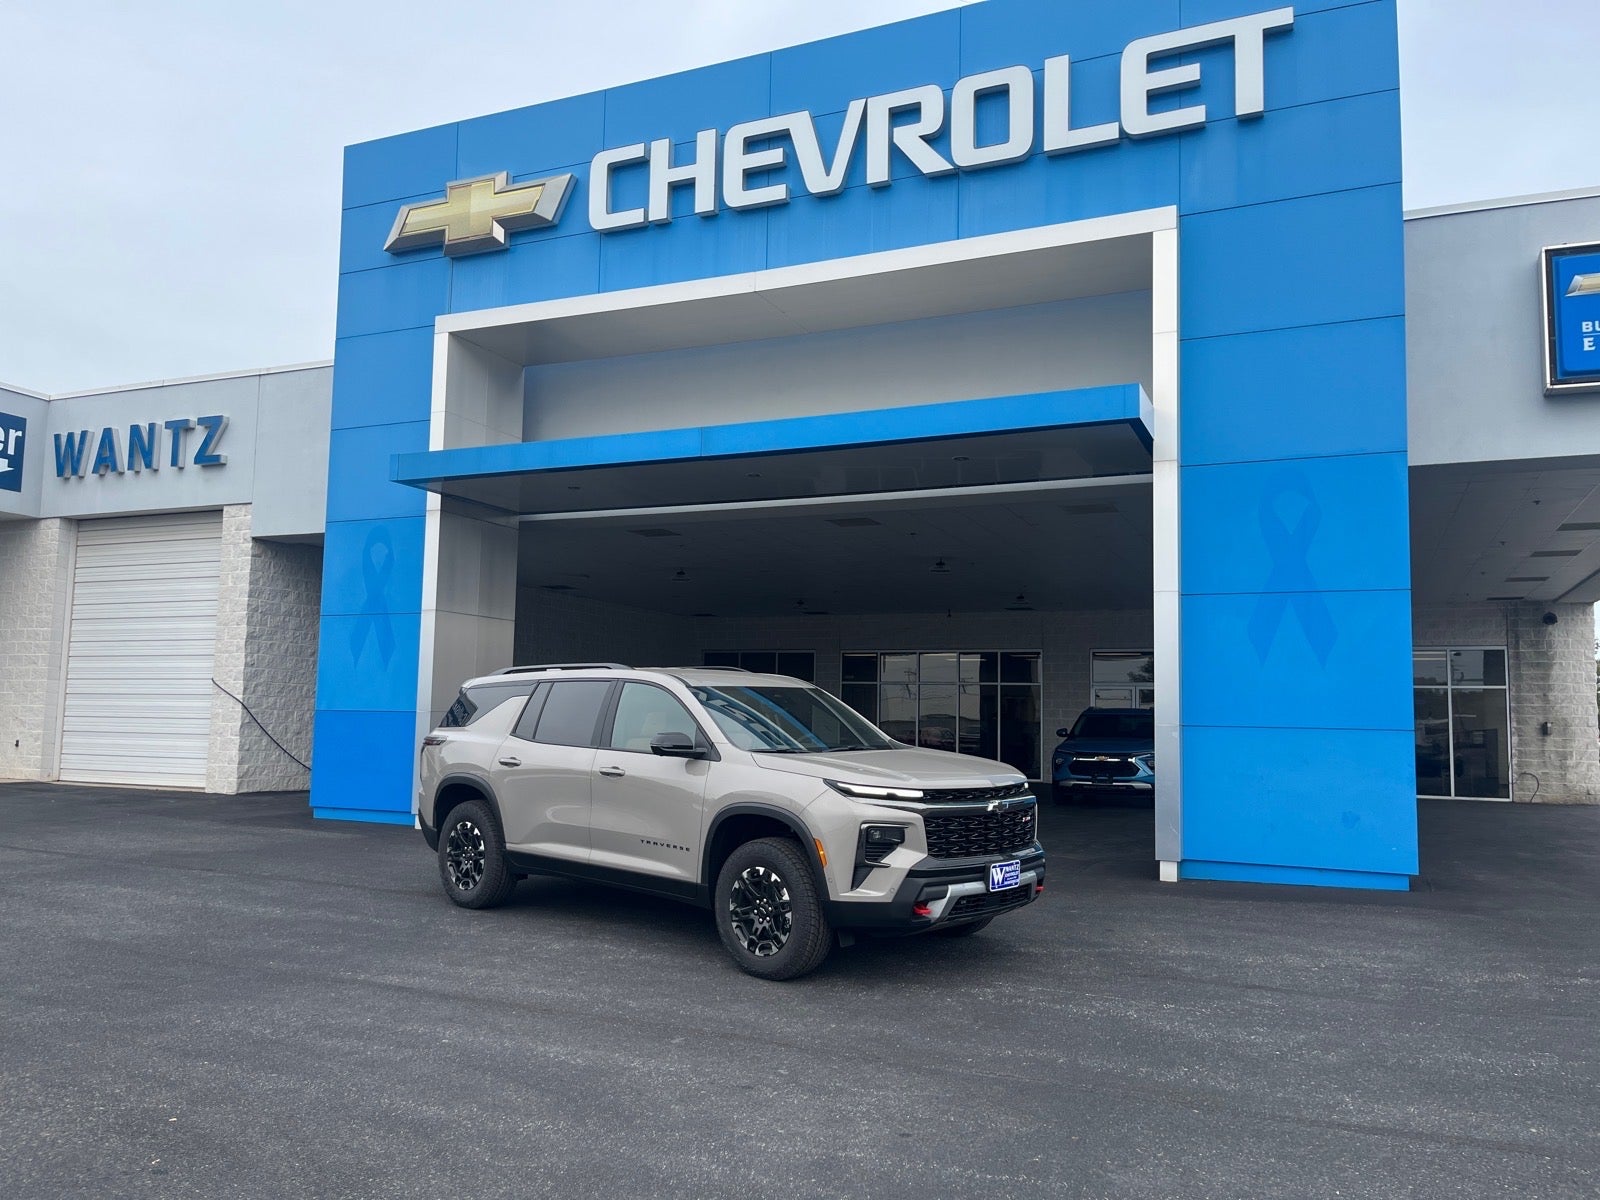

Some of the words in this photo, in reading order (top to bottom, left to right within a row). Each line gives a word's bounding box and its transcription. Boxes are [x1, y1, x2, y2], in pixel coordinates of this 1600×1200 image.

[588, 6, 1294, 233] CHEVROLET
[1582, 337, 1596, 351] E
[54, 415, 228, 479] WANTZ
[641, 839, 690, 852] TRAVERSE
